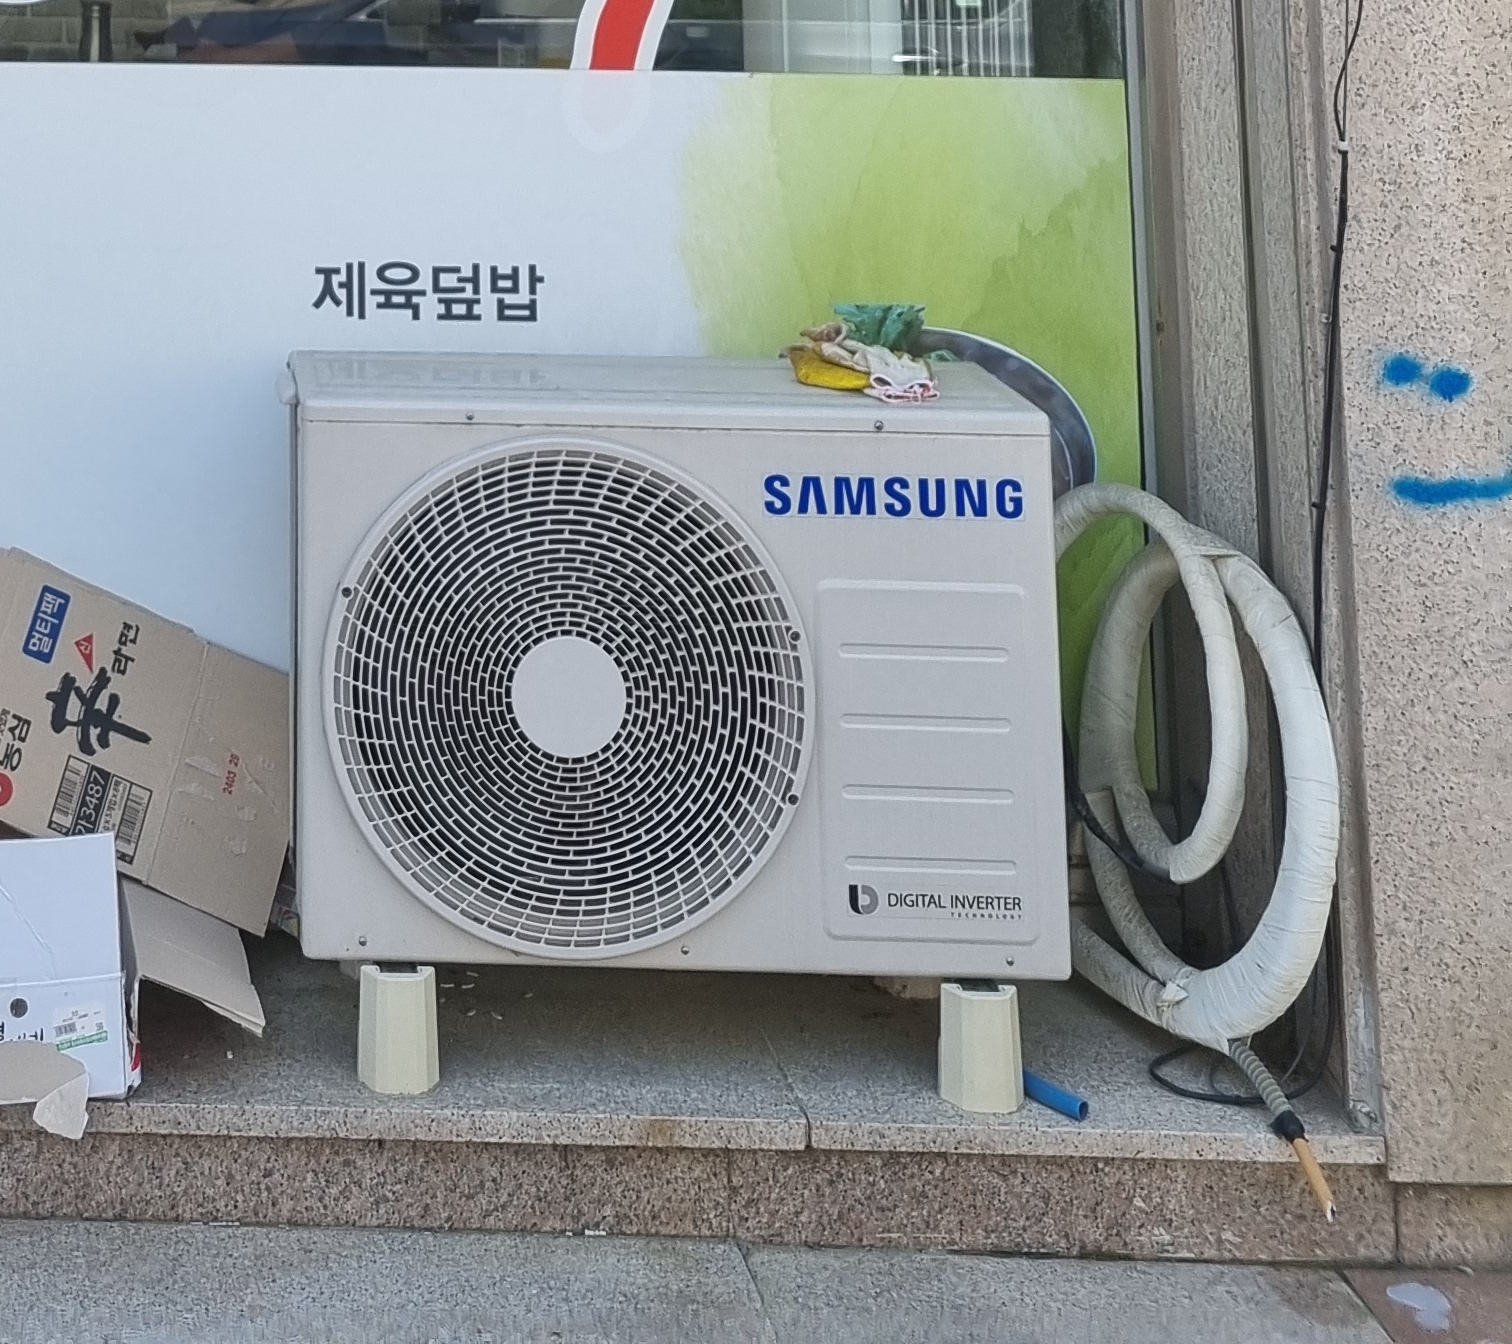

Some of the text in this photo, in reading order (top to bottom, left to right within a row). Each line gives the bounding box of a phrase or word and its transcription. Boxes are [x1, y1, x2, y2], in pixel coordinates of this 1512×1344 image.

[312, 261, 545, 323] 제육덮밥
[763, 474, 1024, 519] SAMSUNG
[28, 592, 65, 653] 멀티팩
[111, 621, 140, 676] 라면
[45, 666, 152, 756] 辛
[887, 892, 1022, 911] DIGITAL INVERTER
[950, 911, 1022, 920] TECHNOLOGY
